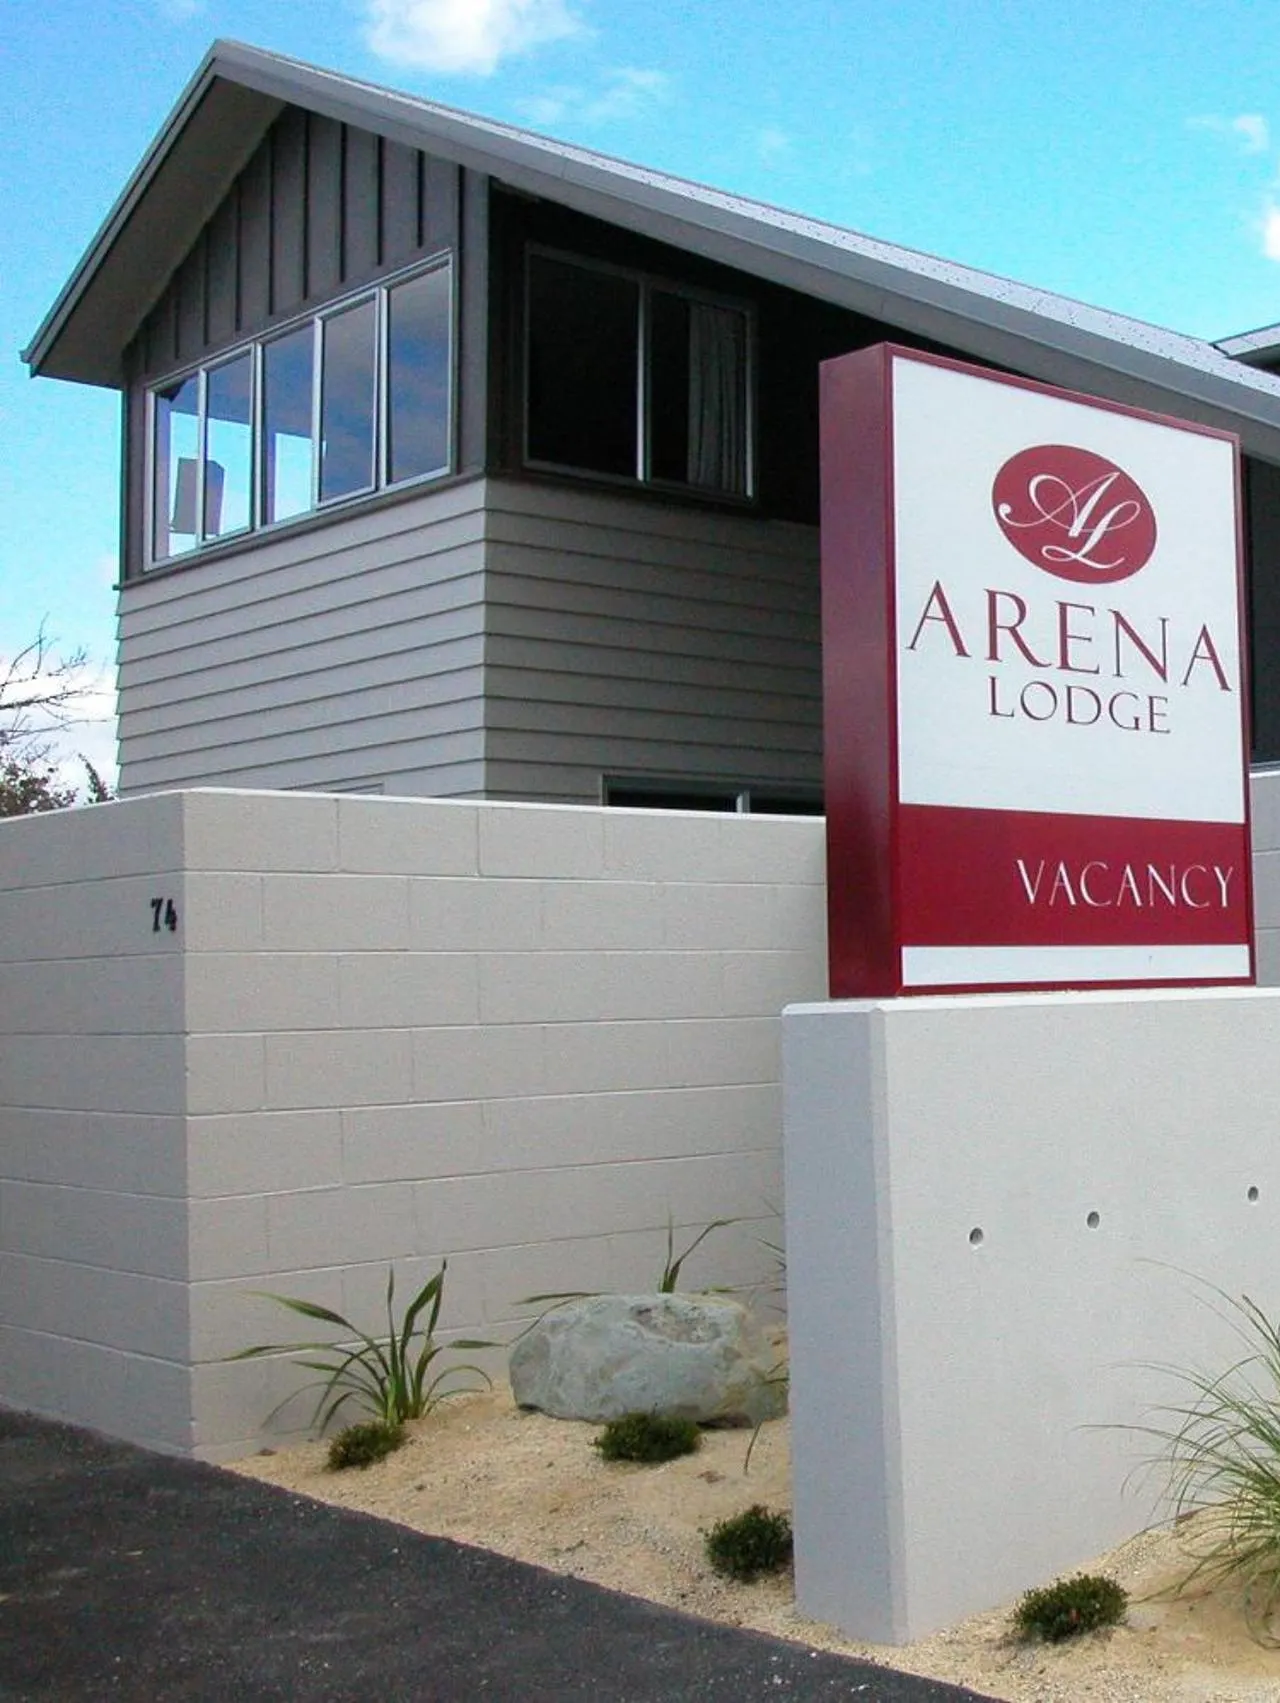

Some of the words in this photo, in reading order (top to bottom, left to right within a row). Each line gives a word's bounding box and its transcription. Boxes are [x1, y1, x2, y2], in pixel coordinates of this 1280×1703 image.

[998, 471, 1141, 569] AL
[905, 579, 1233, 692] ARENA
[989, 676, 1172, 734] LODGE
[1016, 858, 1235, 909] VACANCY
[150, 898, 177, 932] 74
